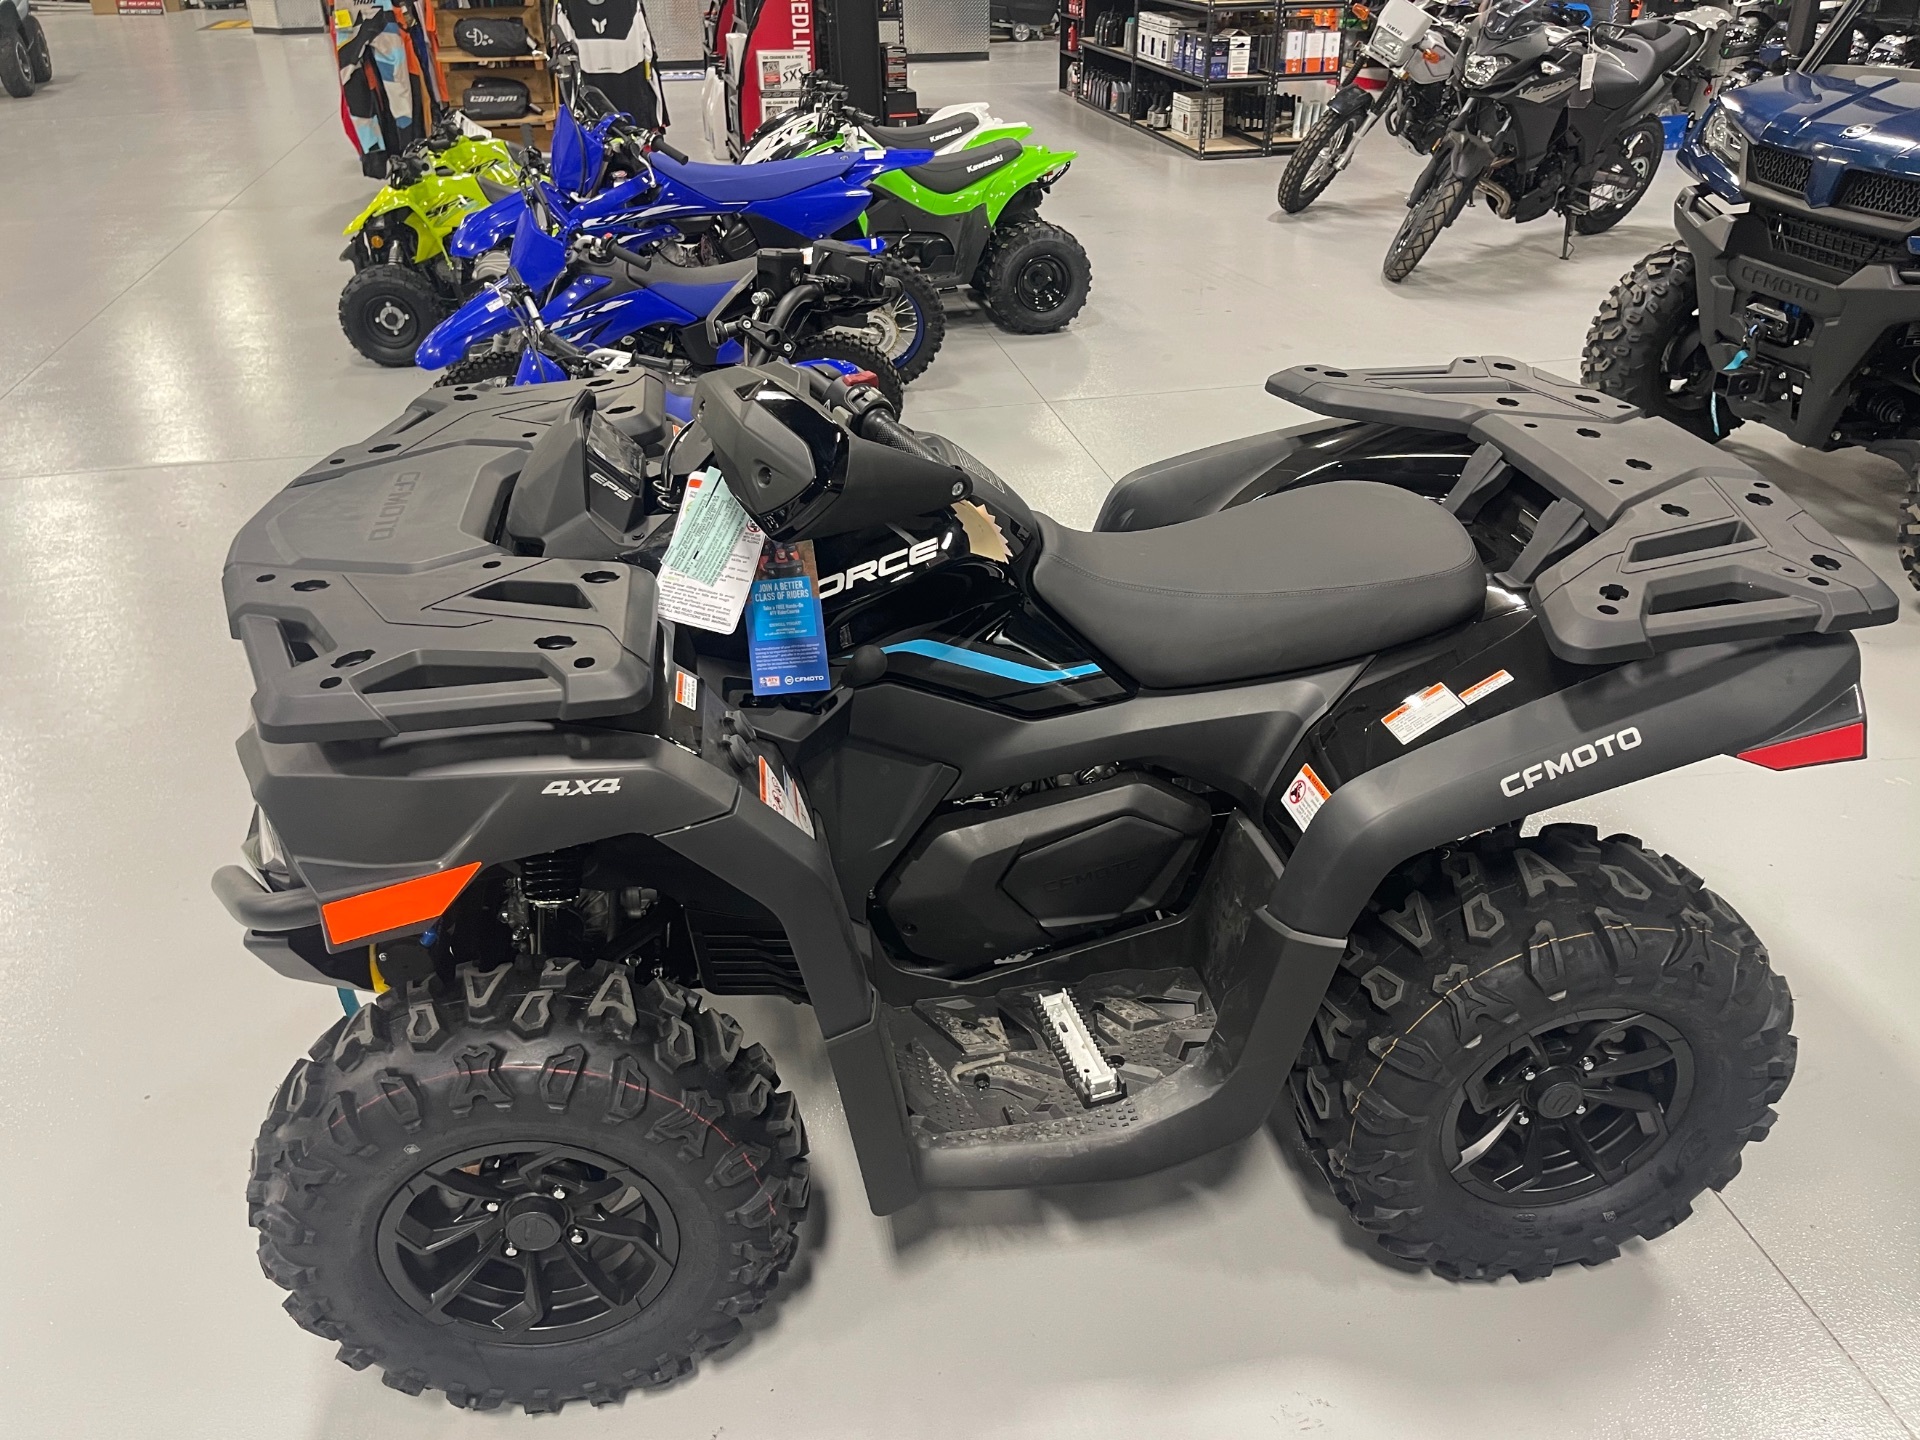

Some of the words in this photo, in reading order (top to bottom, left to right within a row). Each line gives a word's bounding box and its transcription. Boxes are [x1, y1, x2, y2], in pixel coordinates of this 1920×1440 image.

[929, 126, 963, 143] Kawasaki
[966, 154, 1004, 173] Kawasaki
[1742, 266, 1819, 301] CFMOTO
[590, 472, 633, 501] EPS
[368, 471, 421, 541] CFMOTO
[818, 537, 938, 600] ORCE
[755, 593, 775, 602] CLASS
[777, 592, 785, 600] OF
[786, 589, 809, 599] RIDERS
[759, 583, 773, 592] JOIN
[774, 583, 779, 592] A
[780, 581, 804, 591] BETTER
[1499, 726, 1643, 798] CFMOTO
[541, 777, 623, 796] 4X4
